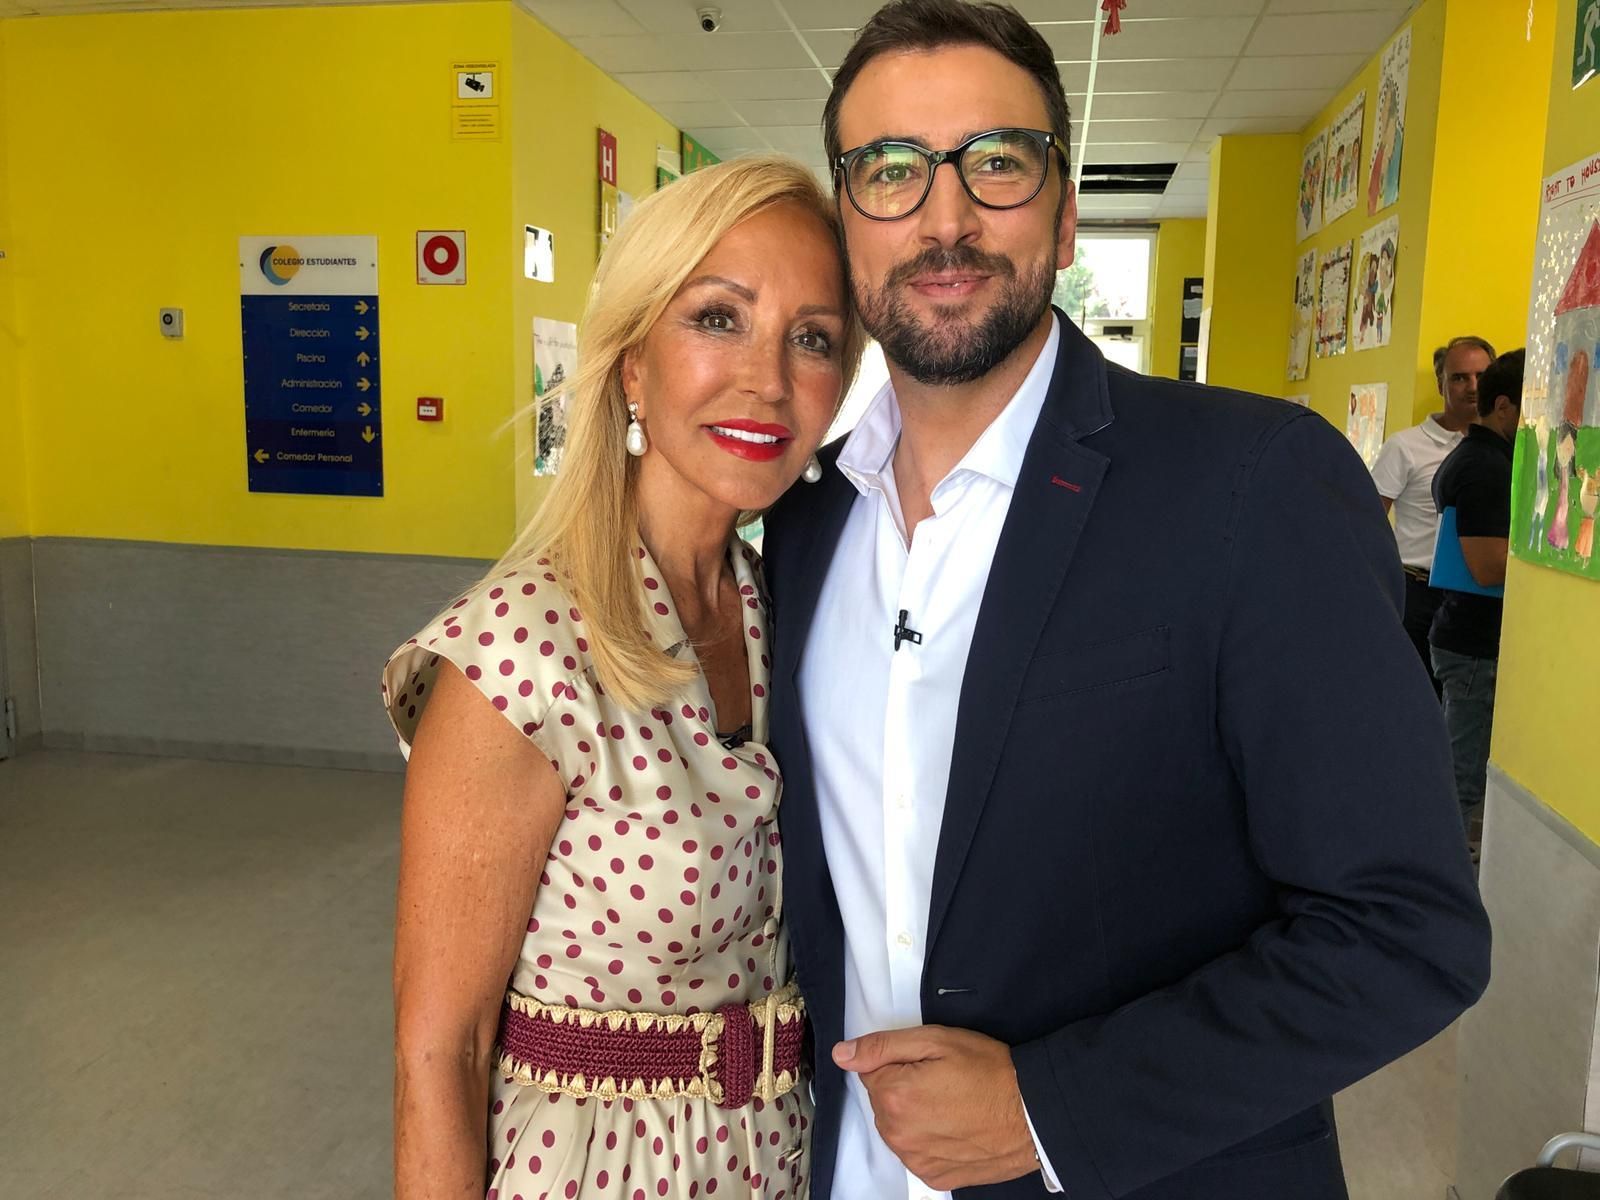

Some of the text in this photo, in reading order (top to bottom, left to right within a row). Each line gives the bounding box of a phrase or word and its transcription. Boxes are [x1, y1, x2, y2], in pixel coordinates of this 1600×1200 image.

[273, 258, 357, 266] COLEGIO ESTUDIANTES
[296, 353, 326, 363] Piscina
[291, 403, 333, 413] Comedor
[276, 451, 353, 463] Comedor Personal
